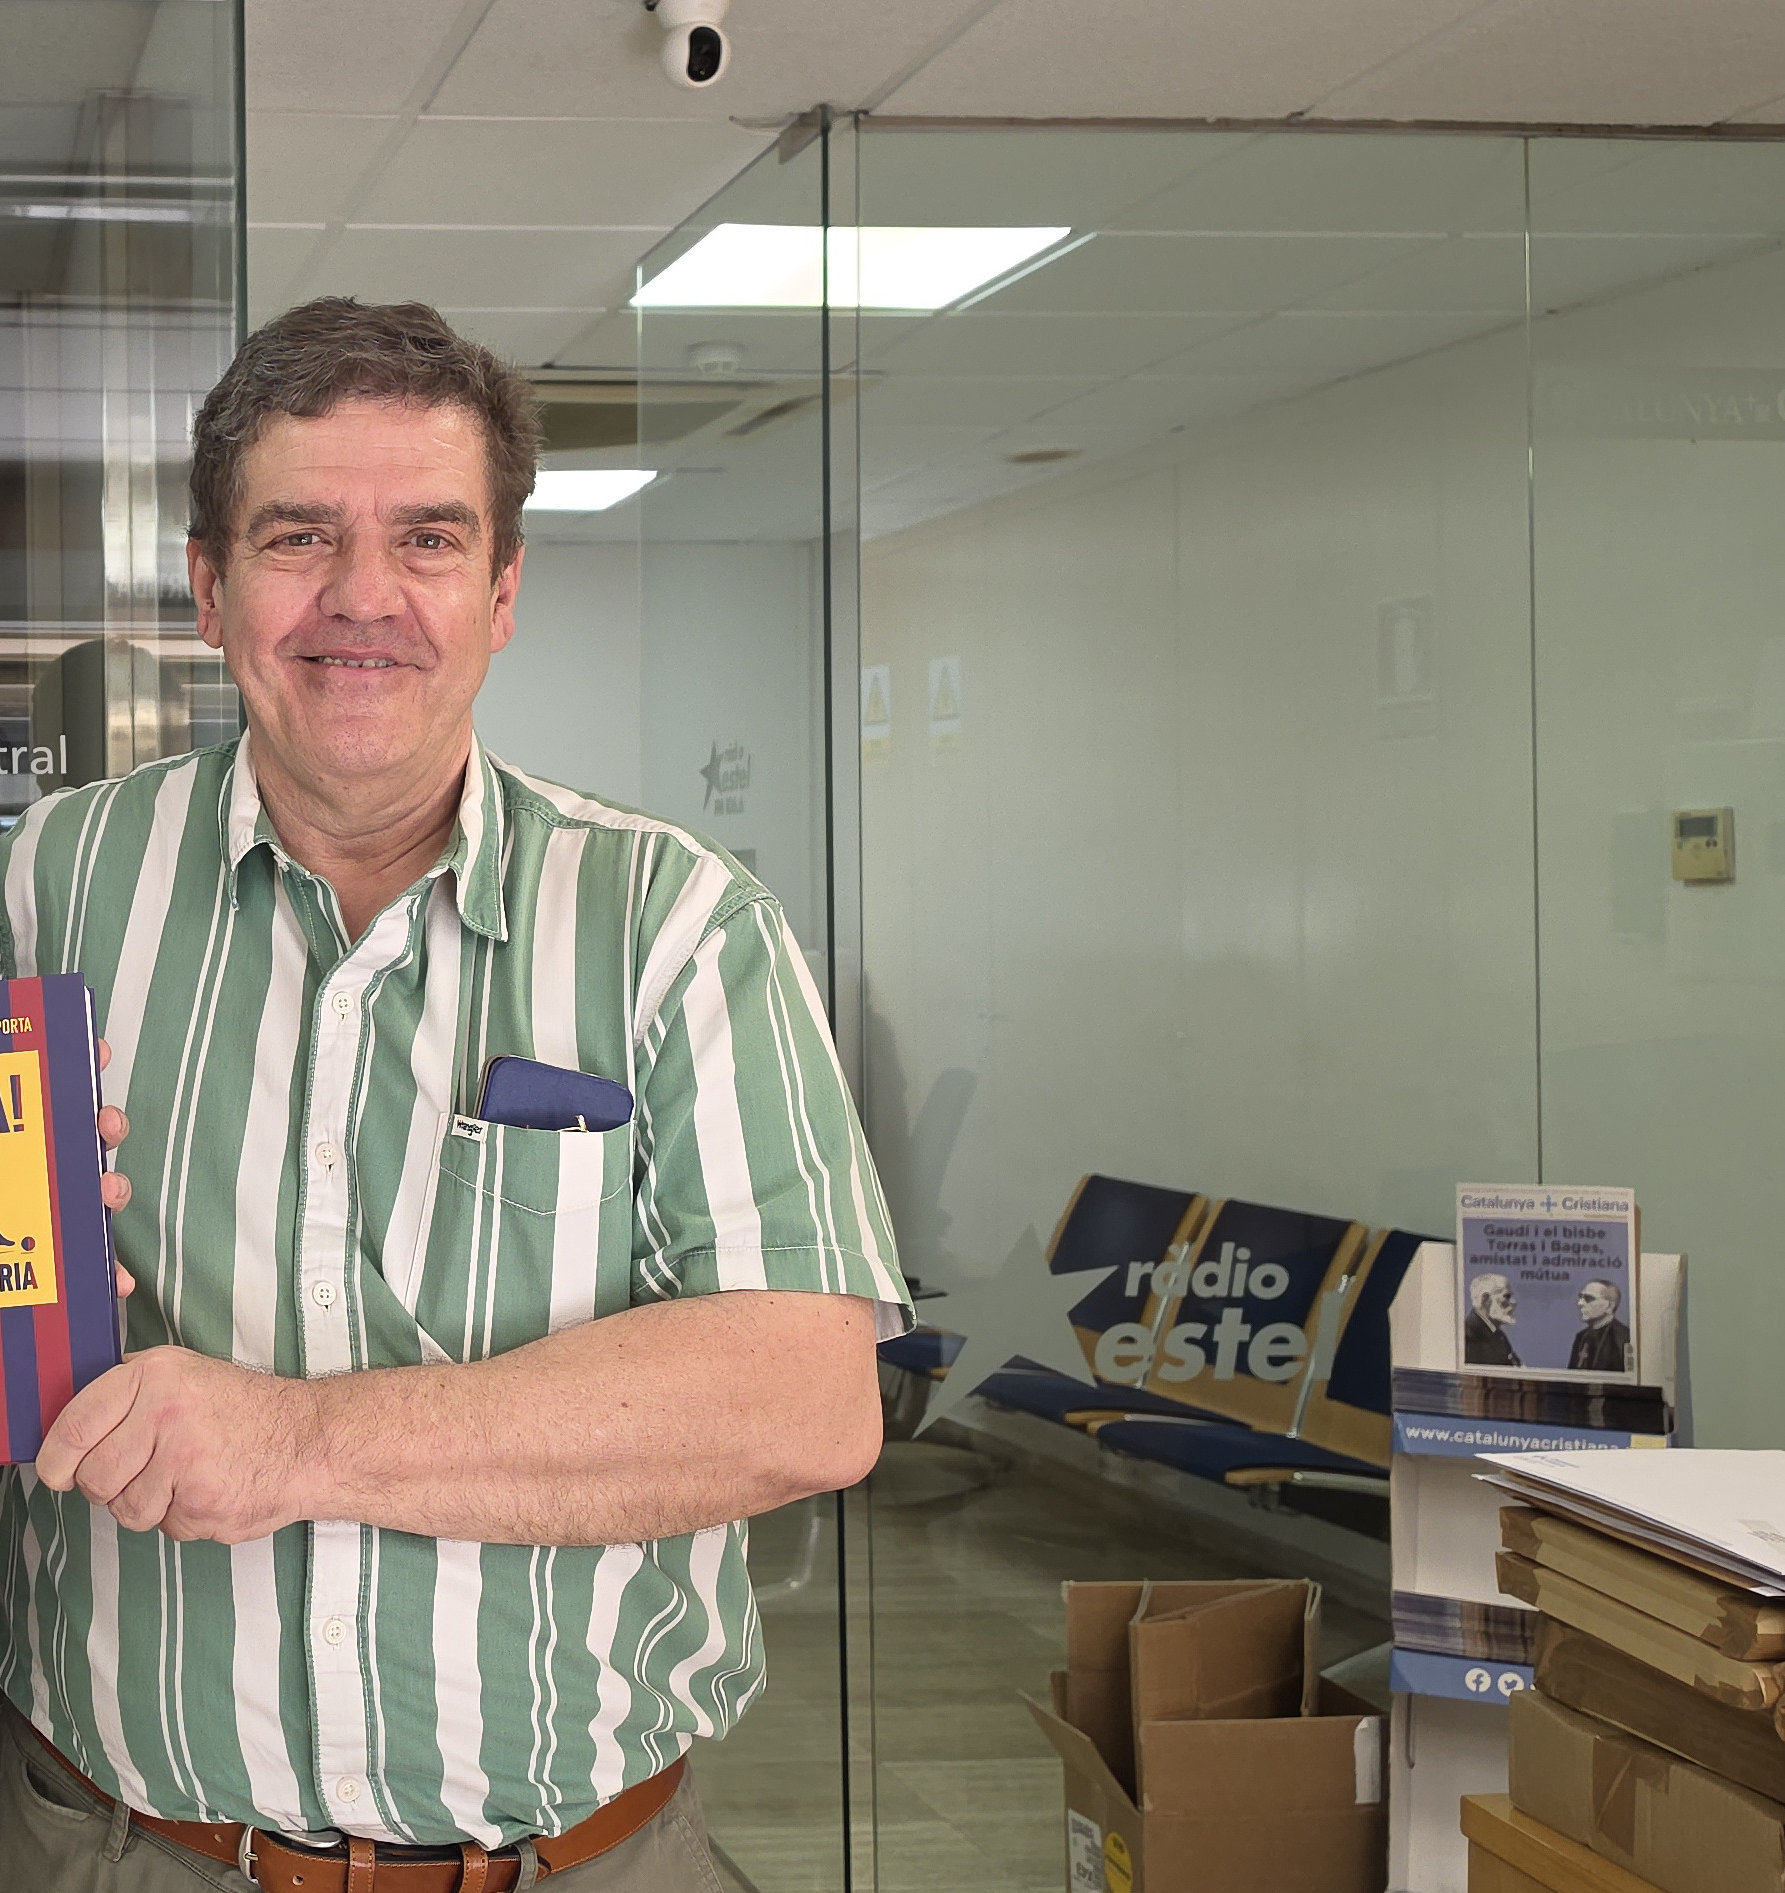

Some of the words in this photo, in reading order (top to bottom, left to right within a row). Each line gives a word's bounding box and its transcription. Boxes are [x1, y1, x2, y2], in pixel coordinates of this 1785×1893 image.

[1461, 1194, 1535, 1212] Catalunya
[1562, 1197, 1629, 1213] Cristiana
[1483, 1223, 1530, 1238] Gaudí
[1543, 1225, 1558, 1237] el
[1562, 1226, 1606, 1240] bisbe
[1487, 1238, 1536, 1251] Torras
[1470, 1253, 1528, 1266] amistat
[1541, 1254, 1623, 1270] admiració
[1125, 1241, 1290, 1300] ràdio
[1520, 1268, 1570, 1281] mútua
[1095, 1291, 1343, 1382] estel
